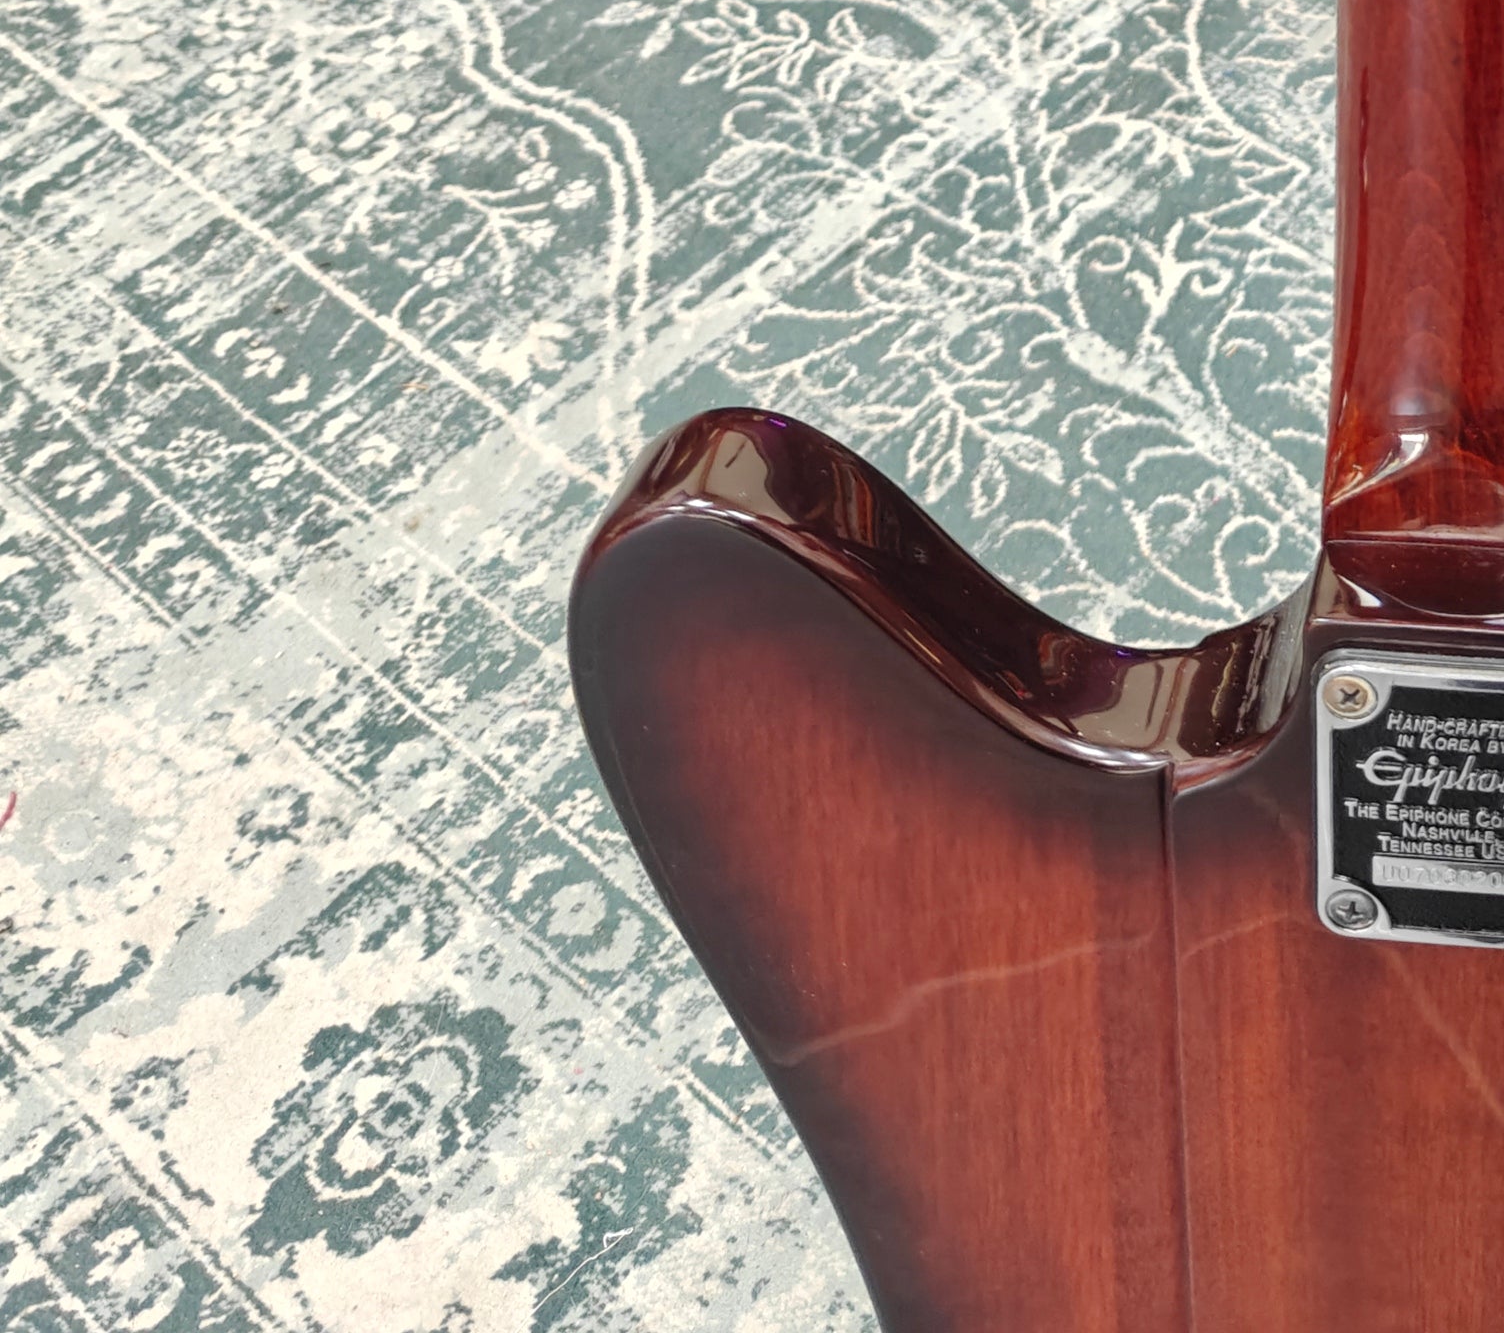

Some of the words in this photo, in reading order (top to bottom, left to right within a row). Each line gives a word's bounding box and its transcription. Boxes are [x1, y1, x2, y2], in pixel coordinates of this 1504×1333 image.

[1397, 733, 1414, 749] IN
[1420, 732, 1481, 753] KOREA
[1344, 798, 1380, 820] THE
[1385, 803, 1471, 827] EPIPHONE
[1377, 834, 1475, 858] TENNESSEE
